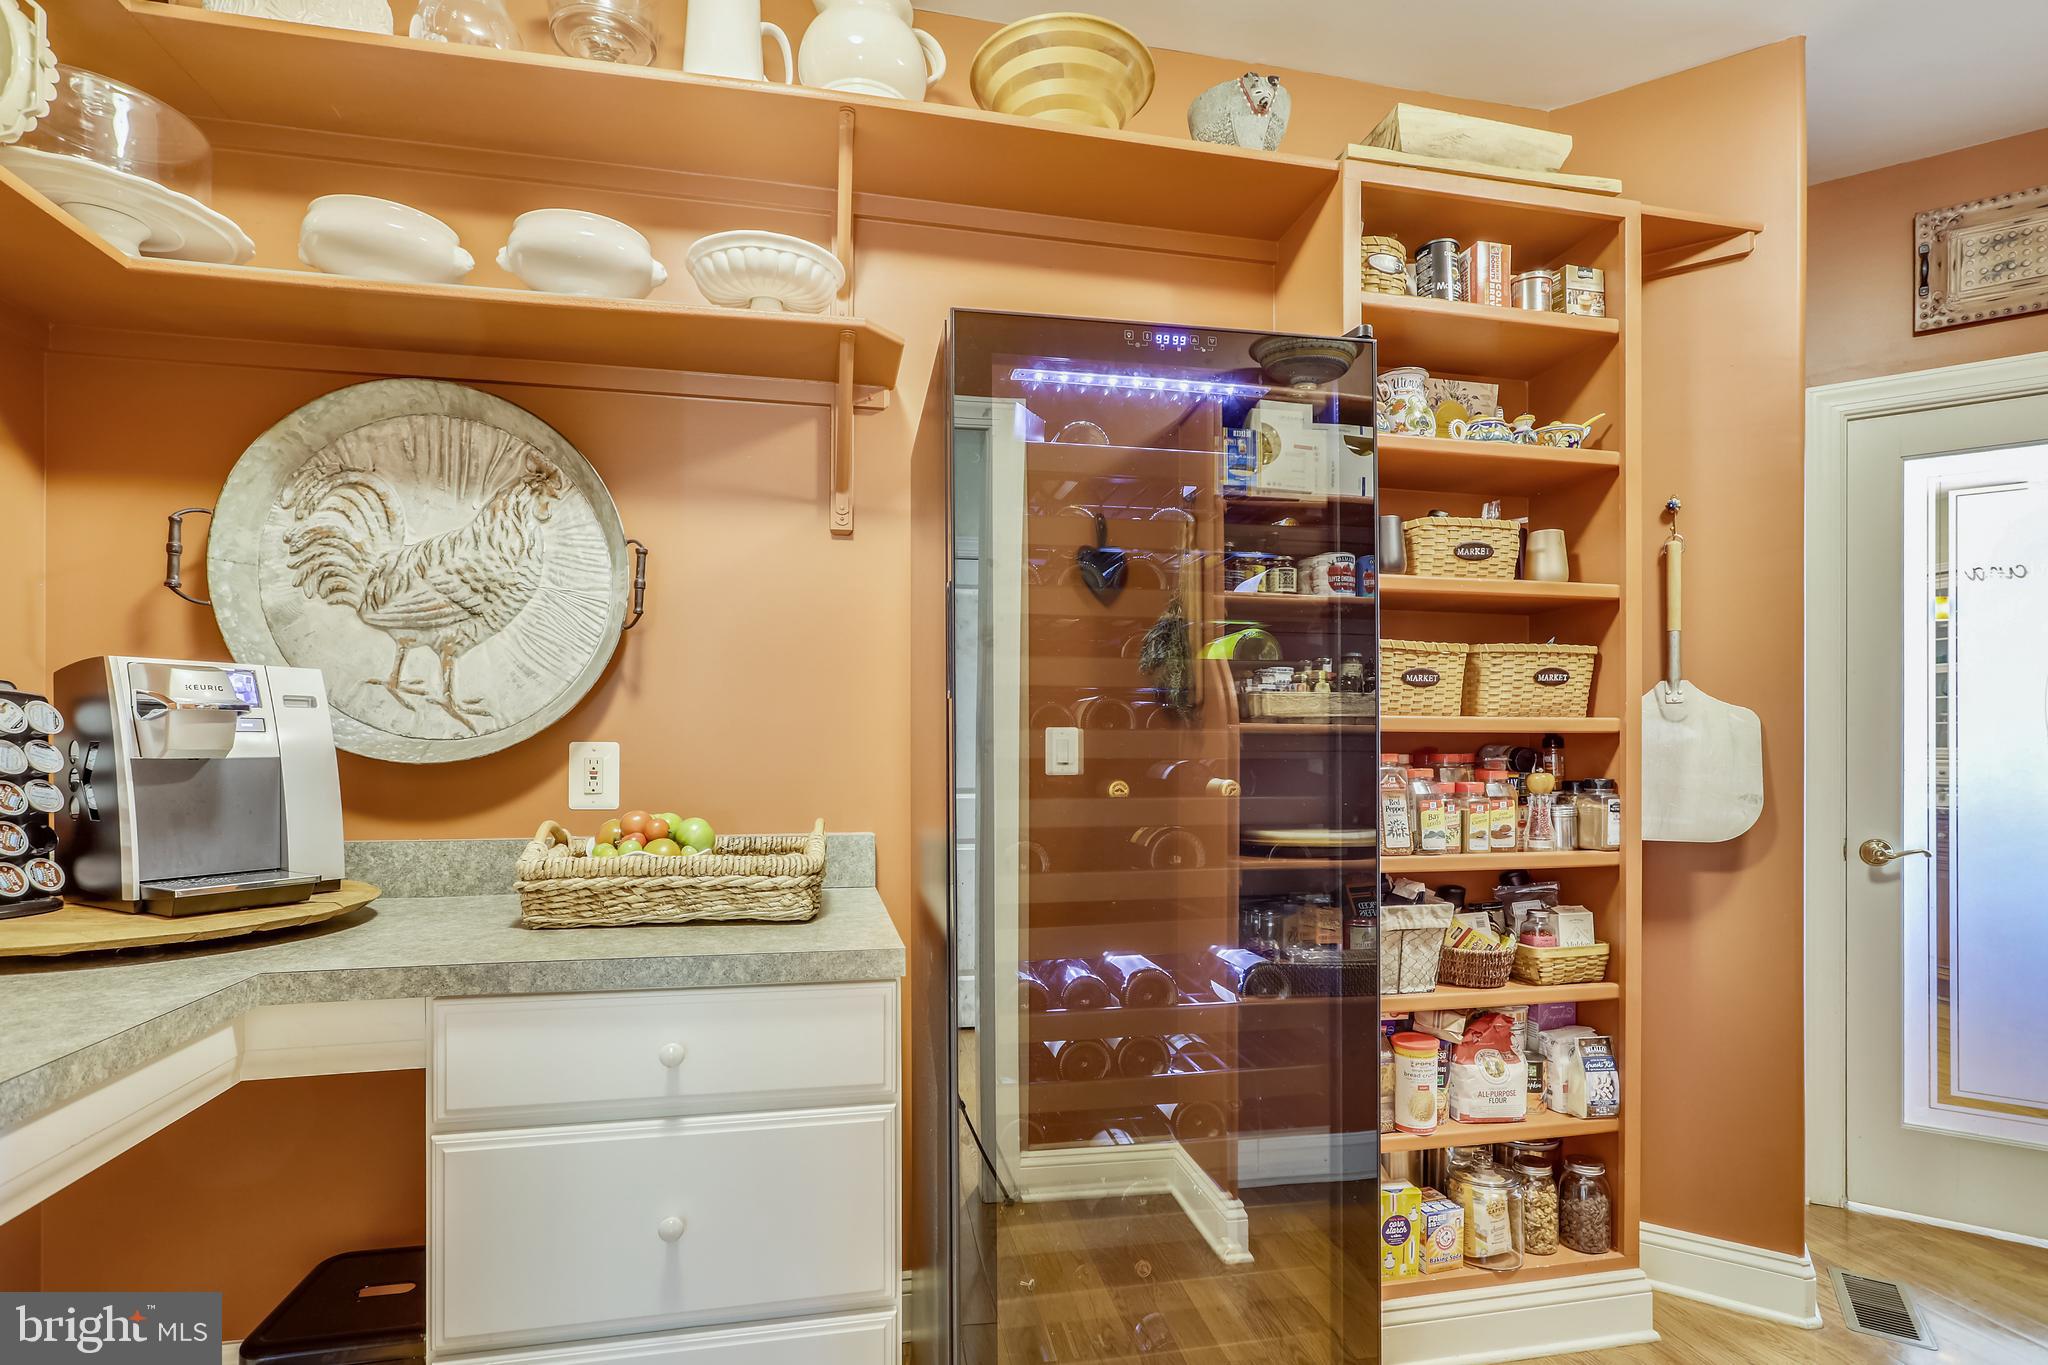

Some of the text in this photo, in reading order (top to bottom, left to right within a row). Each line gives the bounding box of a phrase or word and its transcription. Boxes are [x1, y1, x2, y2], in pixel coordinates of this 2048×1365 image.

[1155, 334, 1187, 346] 99 99
[1457, 547, 1491, 556] MARKET
[1406, 673, 1438, 683] MARKET
[1537, 672, 1568, 682] MARKET
[184, 684, 224, 692] KEURIG
[1385, 805, 1405, 814] Pepper
[1428, 813, 1440, 822] Bay
[1403, 1071, 1421, 1079] bread
[1478, 1090, 1517, 1098] ALL-PURPOSE
[1385, 1225, 1408, 1235] starch
[1429, 1256, 1449, 1264] Baking
